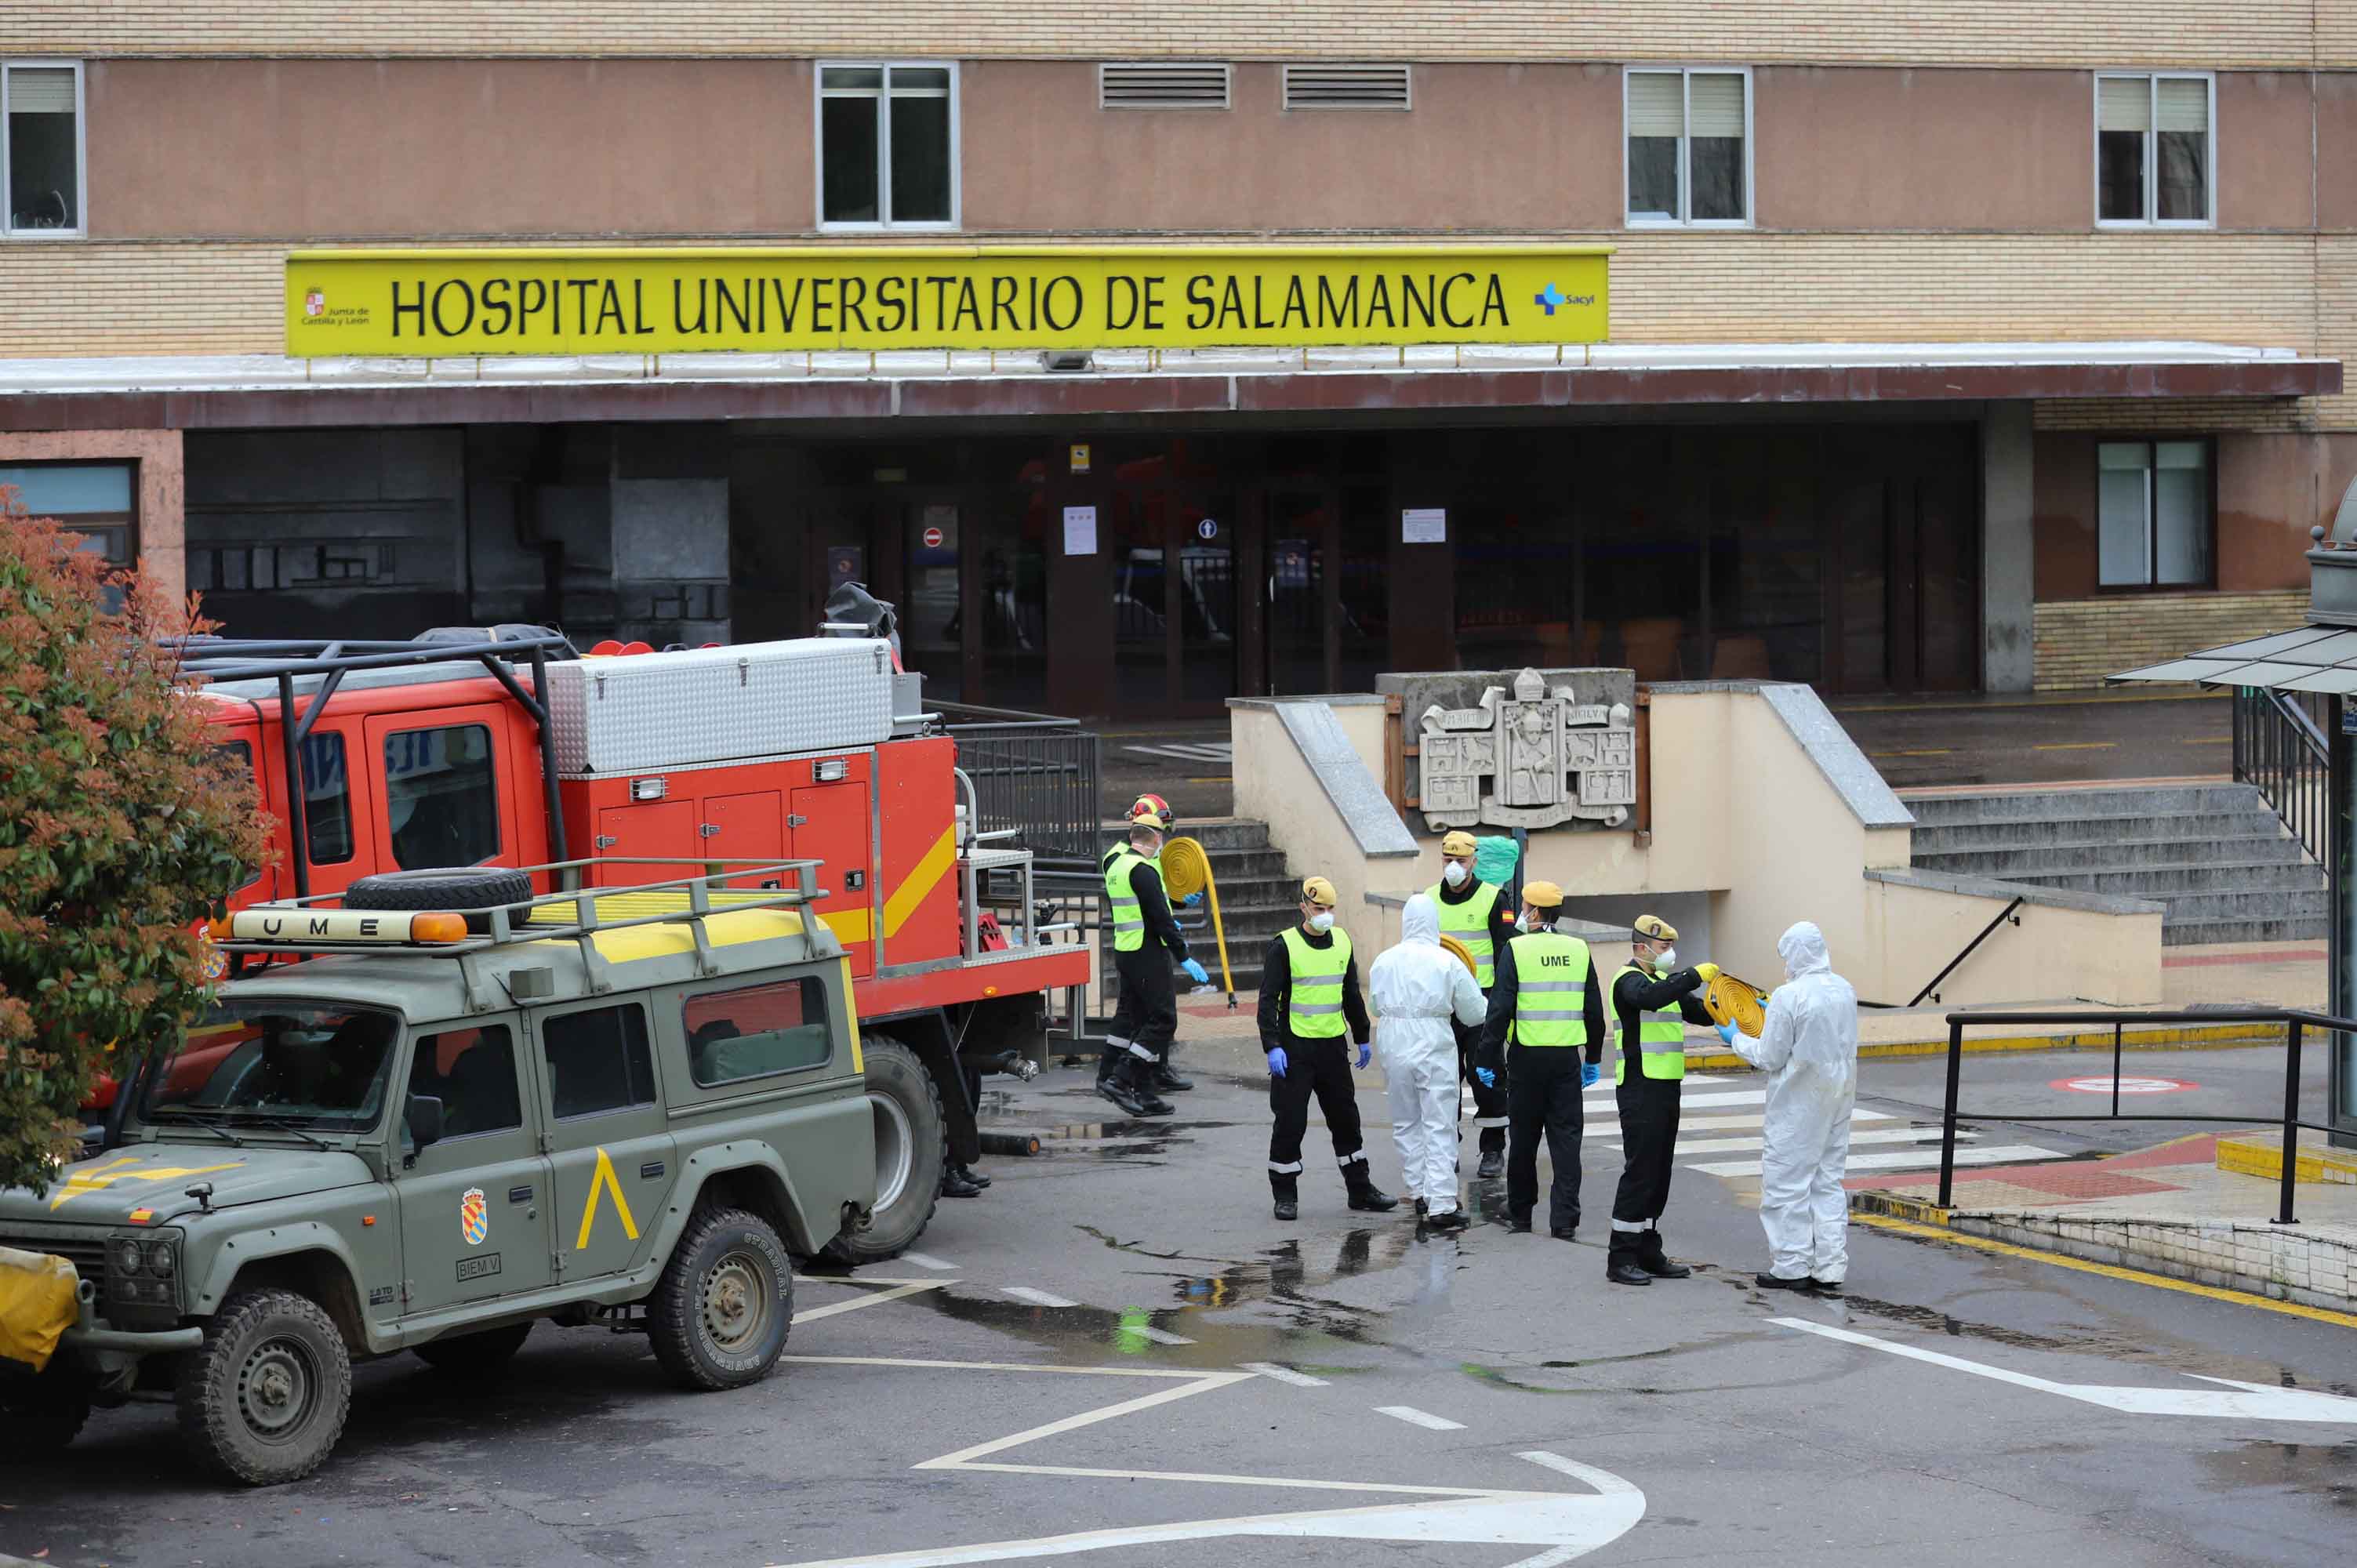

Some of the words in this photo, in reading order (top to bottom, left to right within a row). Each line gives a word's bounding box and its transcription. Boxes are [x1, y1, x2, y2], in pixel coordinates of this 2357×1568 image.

[391, 278, 655, 337] HOSPITAL
[674, 275, 1083, 336] UNIVERSITARIO
[1106, 276, 1165, 332] DE
[1186, 272, 1509, 330] SALAMANCA
[1566, 294, 1595, 307] Sacyl
[329, 307, 355, 316] Junta
[357, 307, 370, 315] de
[301, 316, 336, 326] Castilla
[1541, 955, 1571, 967] UME
[459, 1260, 487, 1277] BIEM
[491, 1257, 498, 1270] V
